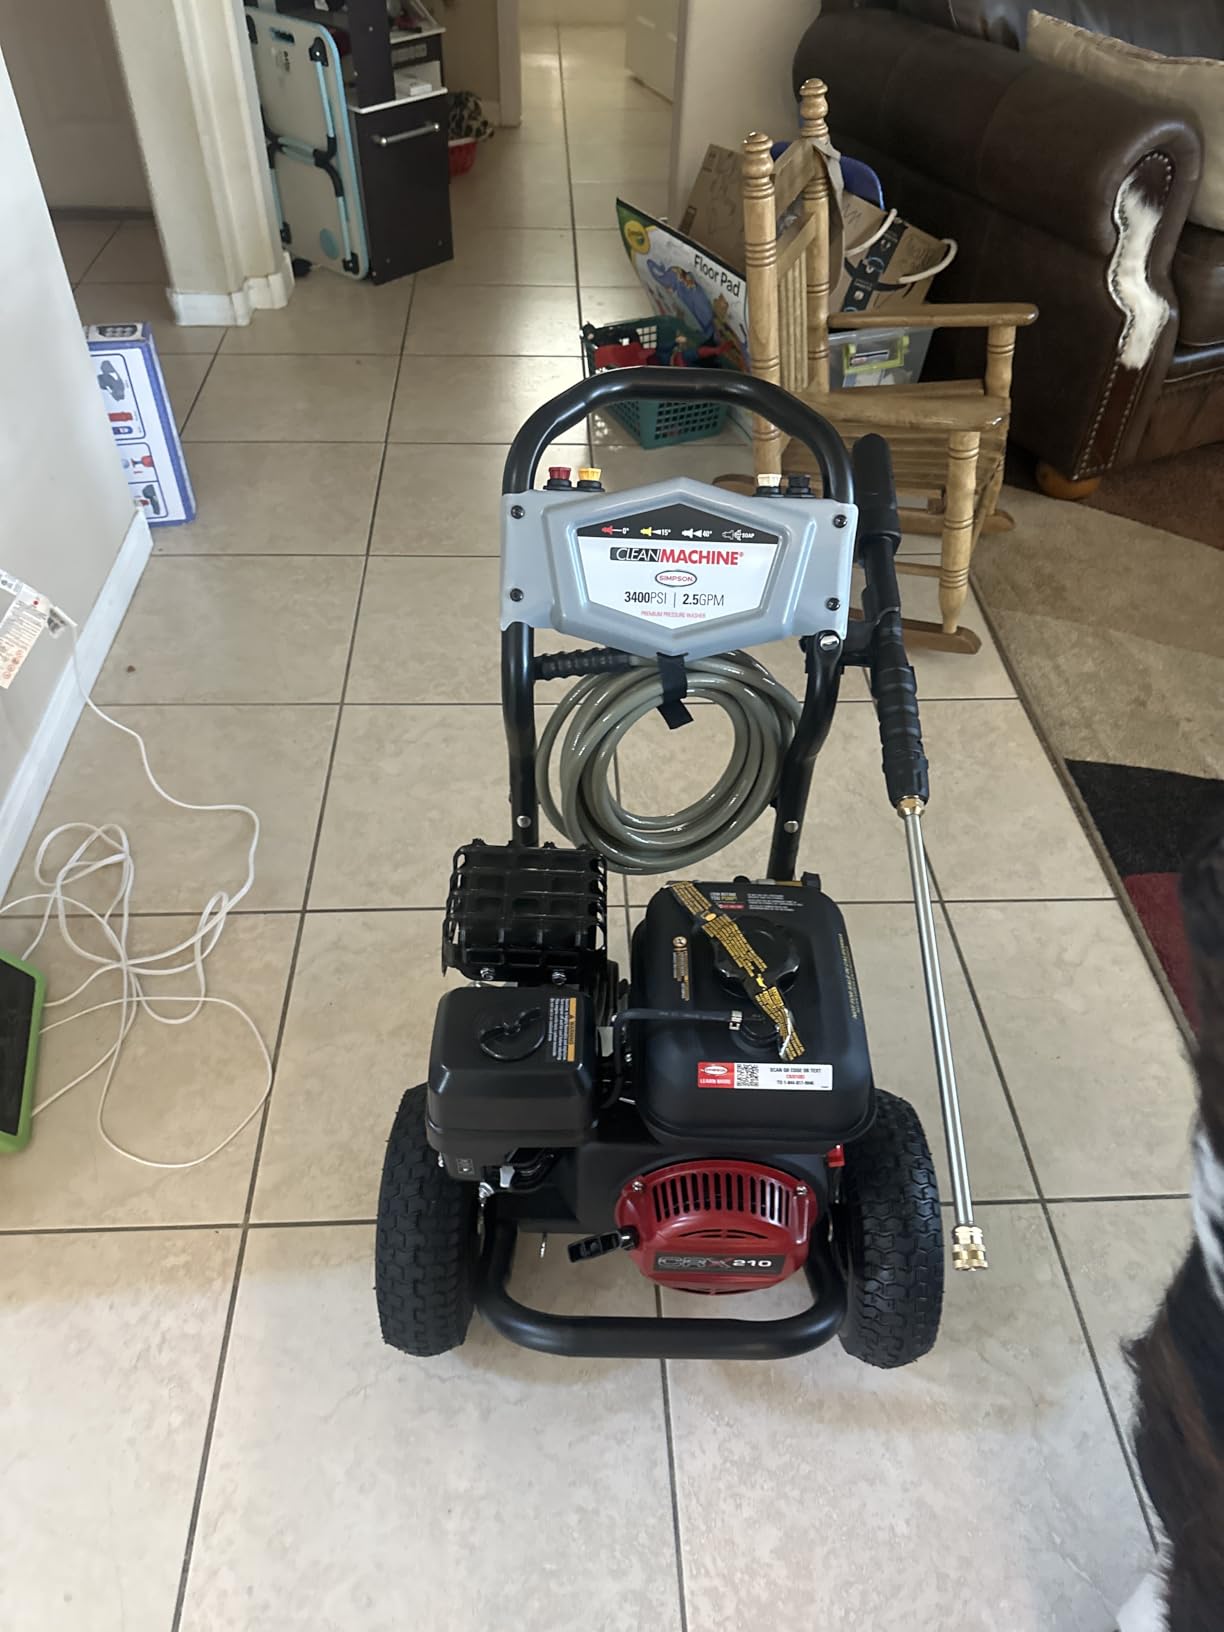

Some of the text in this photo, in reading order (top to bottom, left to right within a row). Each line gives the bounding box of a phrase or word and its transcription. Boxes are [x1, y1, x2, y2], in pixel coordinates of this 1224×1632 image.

[694, 255, 741, 298] Floor Pad
[624, 591, 724, 606] 3400PSI 2.5GPM
[732, 1259, 772, 1267] 210
